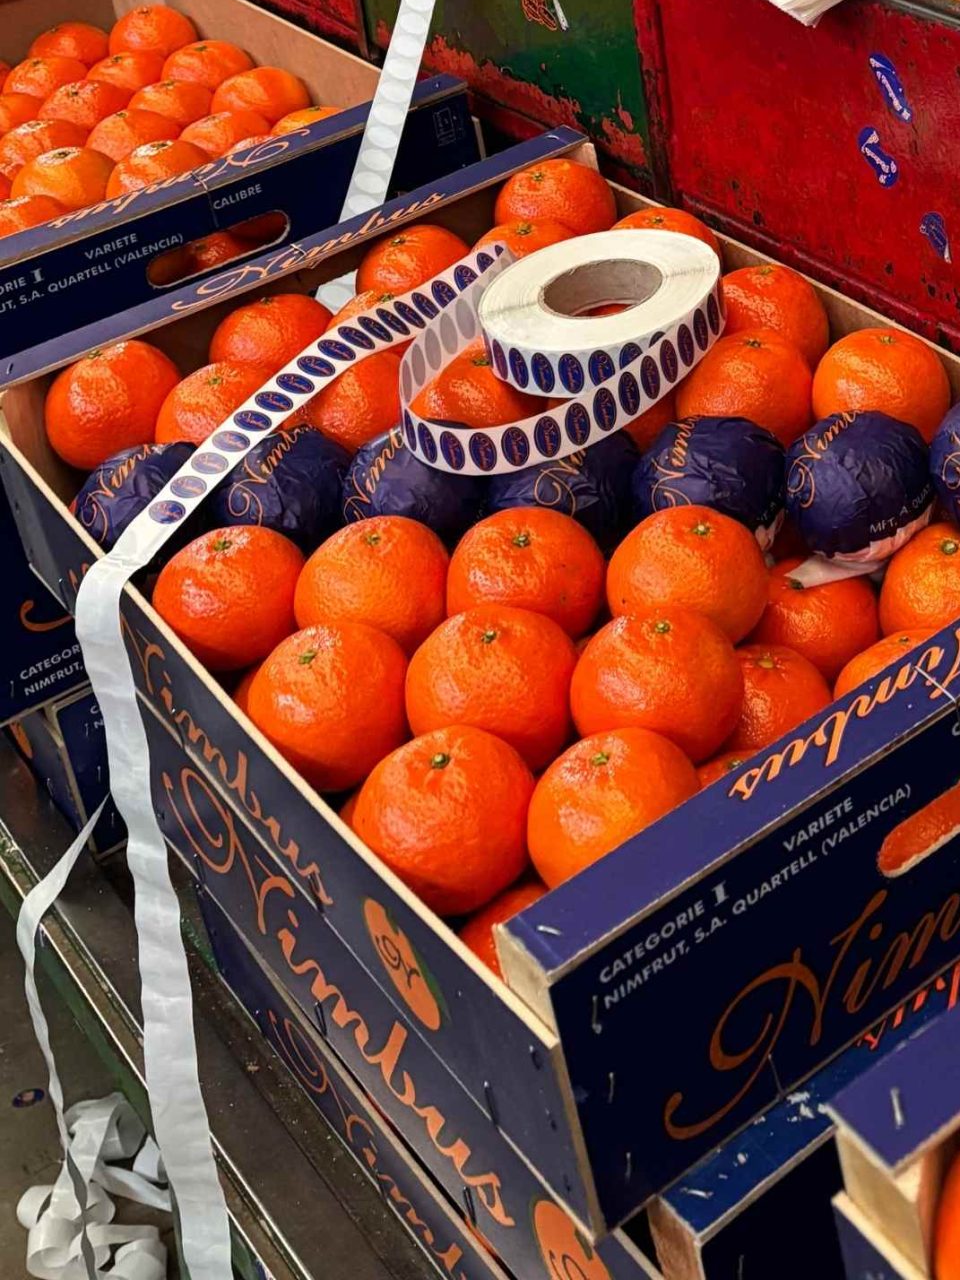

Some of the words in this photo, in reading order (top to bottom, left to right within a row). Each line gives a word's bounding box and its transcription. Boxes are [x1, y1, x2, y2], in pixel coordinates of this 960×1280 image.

[213, 183, 263, 210] CALIBRE
[19, 287, 45, 305] S.A.
[48, 263, 112, 293] QUARTELL
[114, 233, 184, 269] (VALENCIA)
[84, 233, 138, 260] VARIETE
[19, 643, 81, 681] CATEGOR
[782, 797, 854, 852] VARIETE
[603, 940, 691, 1010] NIMFRUT,
[693, 917, 728, 944] S.A.
[731, 850, 818, 915] QUARTELL
[821, 783, 912, 856] (VALENCIA)
[599, 900, 705, 984] CATEGORIE
[162, 766, 516, 1227] Nimbus
